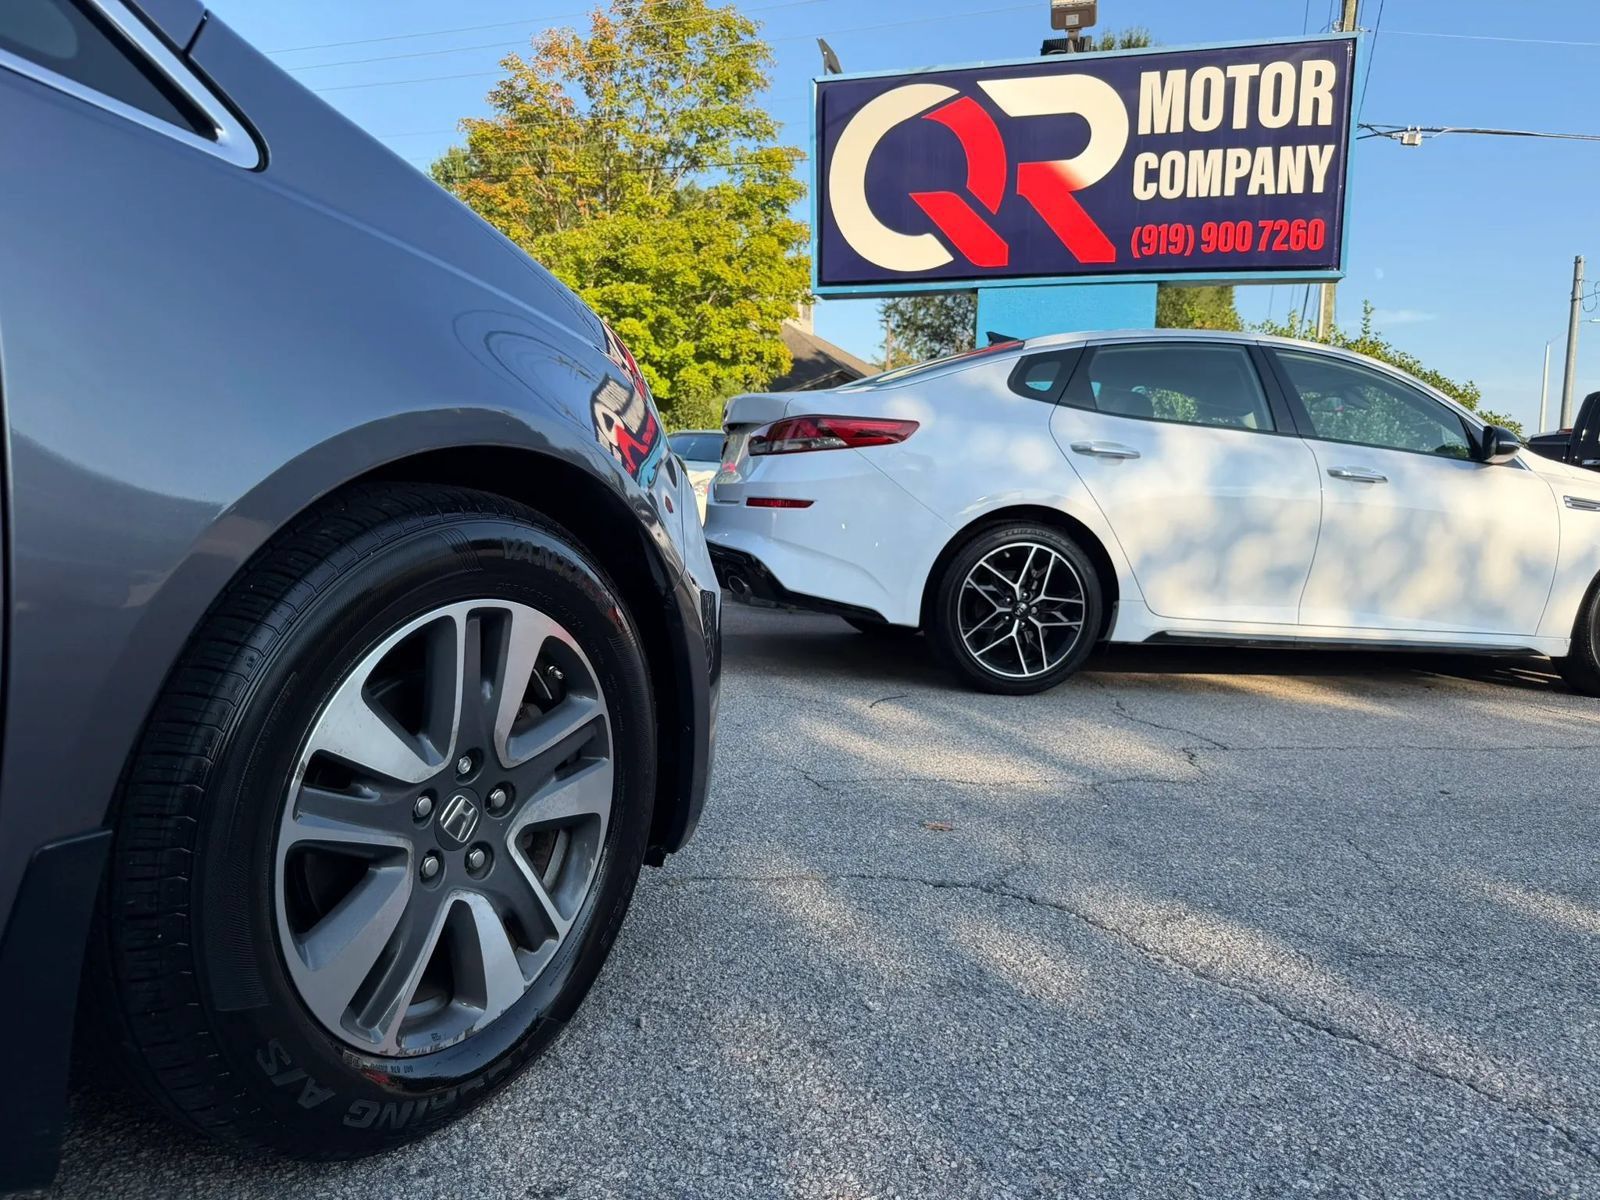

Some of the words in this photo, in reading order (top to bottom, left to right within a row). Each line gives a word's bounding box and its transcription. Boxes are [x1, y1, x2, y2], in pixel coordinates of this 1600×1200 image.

[1138, 60, 1337, 136] MOTOR
[1133, 144, 1336, 201] COMPANY
[1131, 223, 1195, 259] (919)
[1201, 221, 1252, 254] 900
[1257, 219, 1325, 252] 7260
